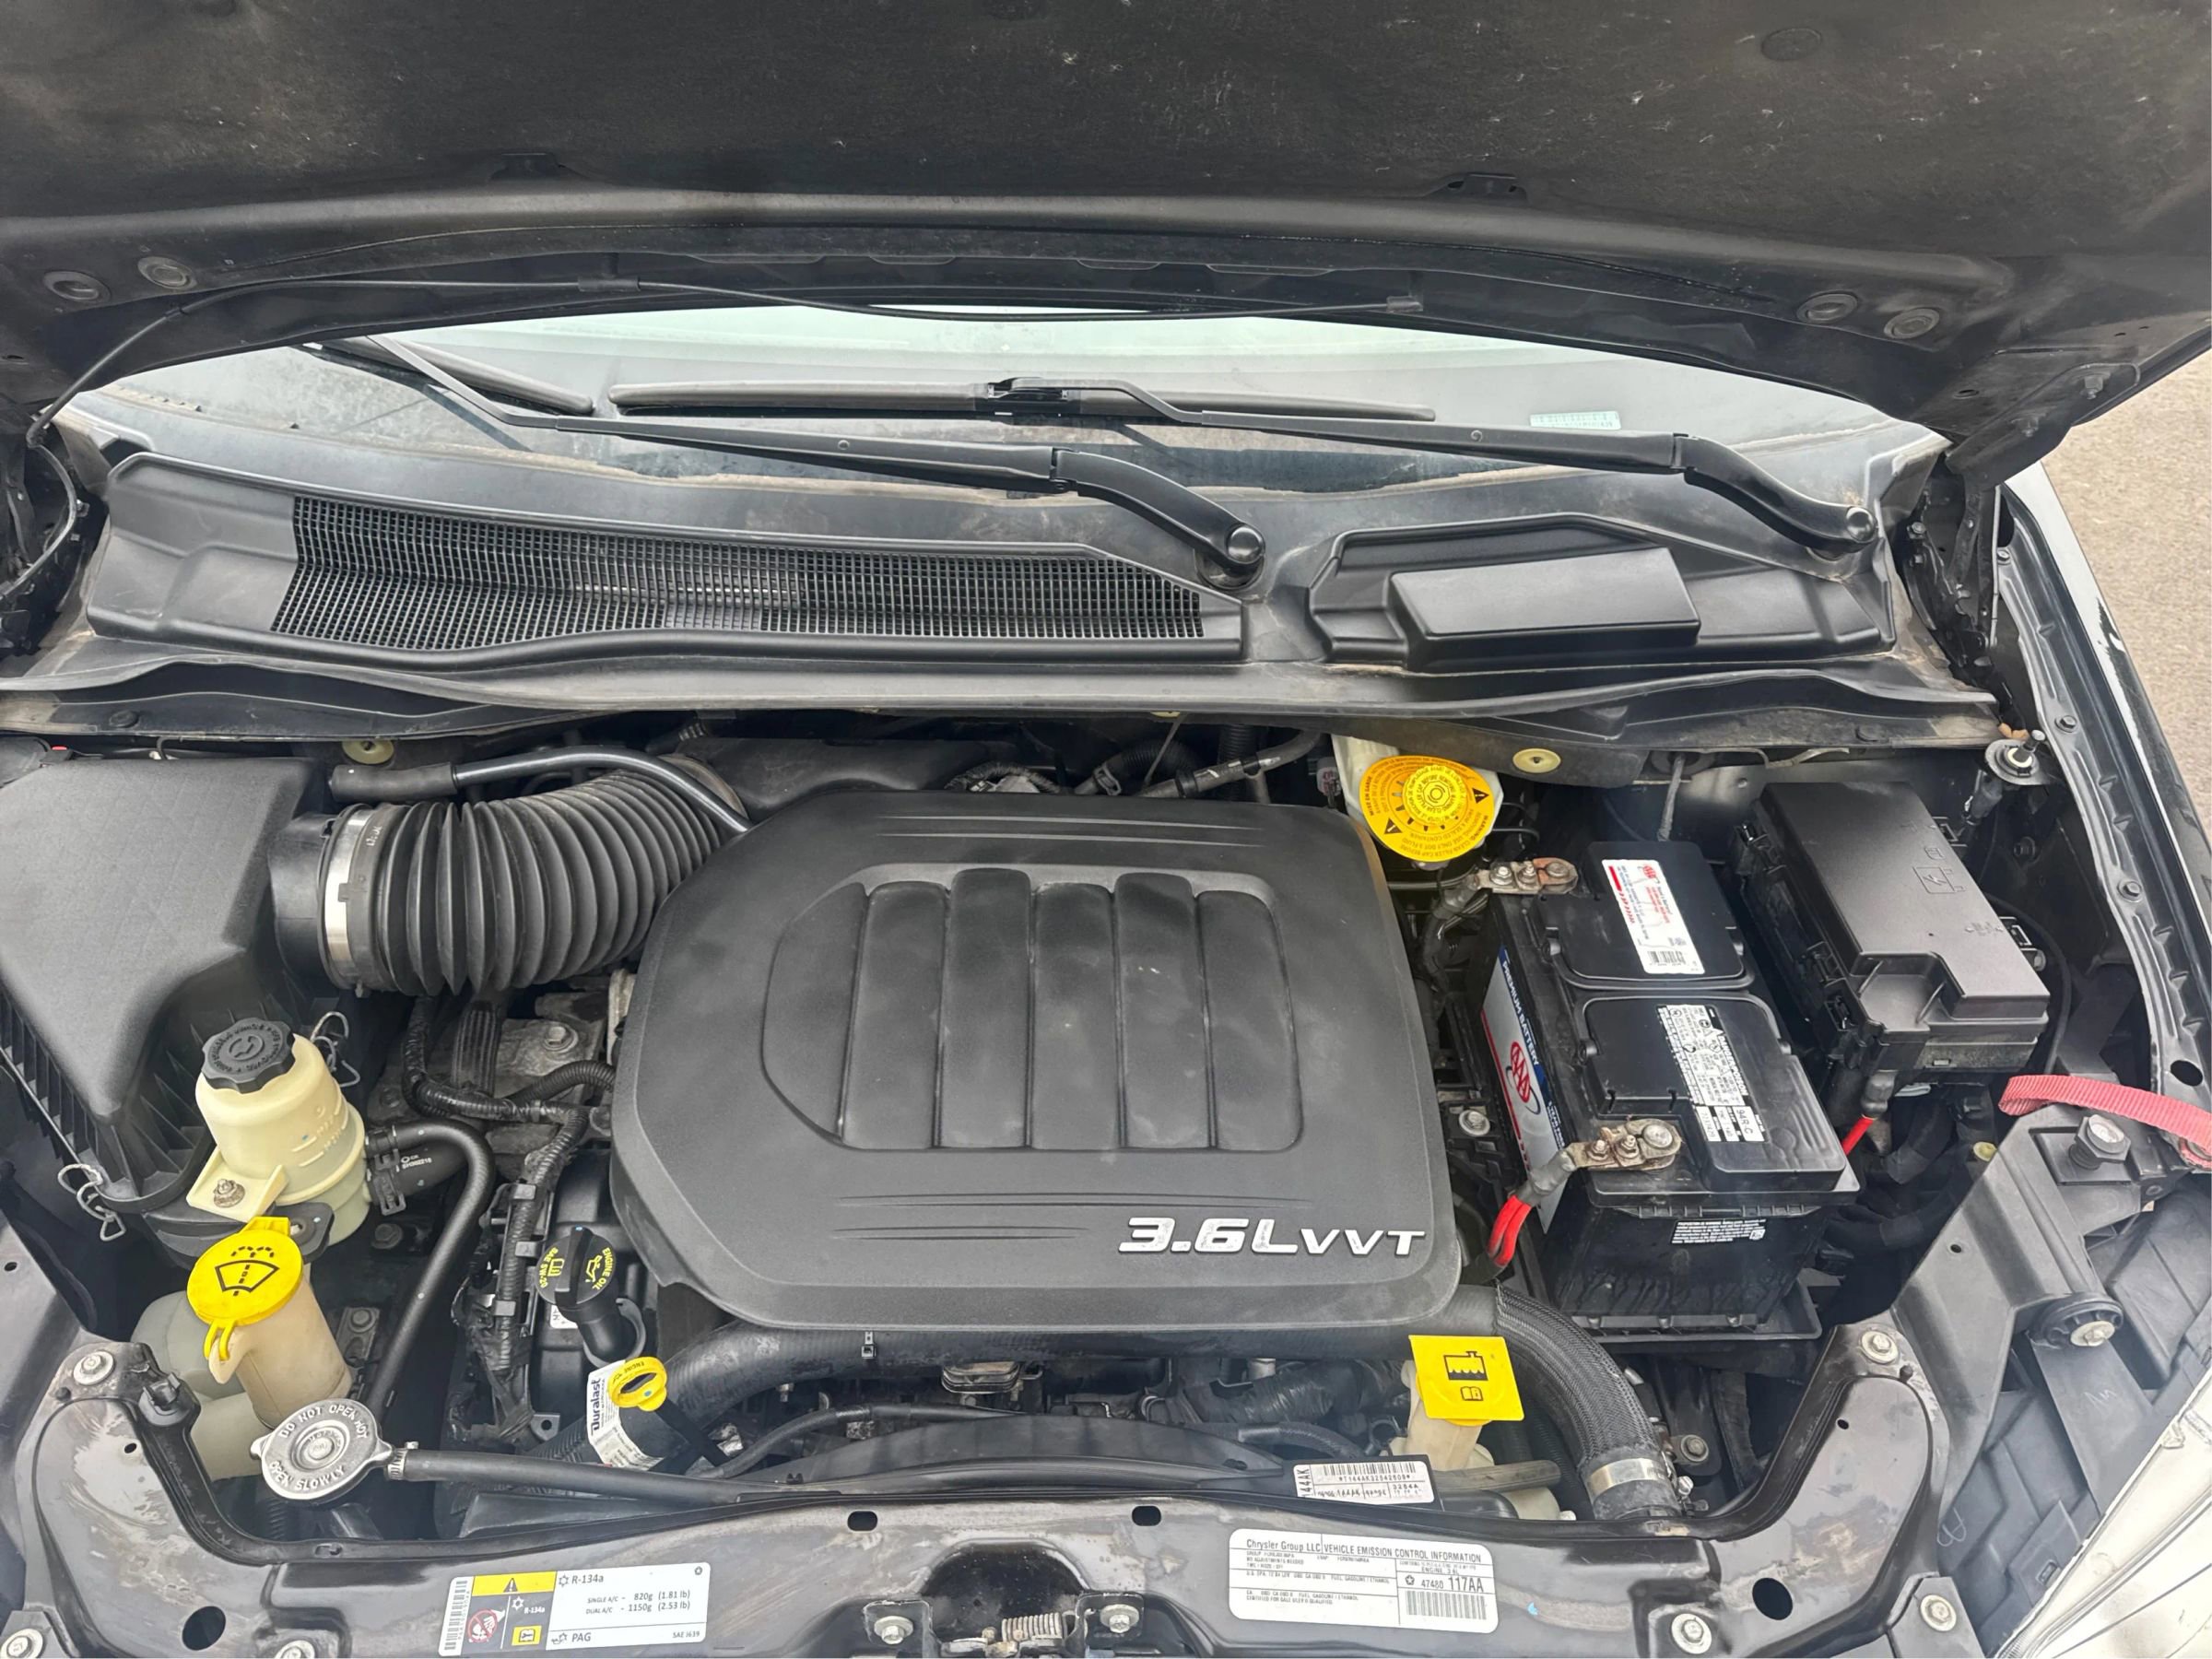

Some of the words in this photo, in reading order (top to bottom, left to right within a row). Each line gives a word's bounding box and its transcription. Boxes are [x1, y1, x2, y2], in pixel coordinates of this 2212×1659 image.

[1502, 960, 1522, 1014] PREMIUM
[1521, 1013, 1540, 1067] BATTERY
[1510, 1043, 1531, 1102] AAA
[1118, 1217, 1299, 1254] 3.6L
[1300, 1228, 1426, 1255] VVT
[544, 1247, 559, 1263] SAE
[602, 1248, 615, 1277] ENGINE
[592, 1277, 606, 1290] OIL
[625, 1360, 645, 1374] ENGINE
[590, 1378, 602, 1436] Duralast
[278, 1423, 296, 1439] DO
[298, 1406, 323, 1423] NOT
[328, 1405, 359, 1421] OPEN
[354, 1419, 369, 1440] HOT
[269, 1459, 295, 1488] OPEN
[295, 1465, 347, 1491] SLOWLY
[1246, 1539, 1279, 1551] Chrysler
[1281, 1540, 1304, 1554] Group
[1306, 1541, 1321, 1552] LLC
[1324, 1543, 1355, 1554] VEHICLE
[1357, 1546, 1393, 1558] EMISSION
[1394, 1548, 1429, 1559] CONTROL
[1430, 1550, 1482, 1563] INFORMATION
[571, 1574, 605, 1584] R-134a
[1421, 1580, 1443, 1589] 47480
[1449, 1576, 1484, 1593] 117AA
[633, 1592, 653, 1602] 820g
[658, 1591, 677, 1600] (1.81
[679, 1589, 691, 1600] lb)
[524, 1606, 546, 1615] R-134a
[599, 1606, 614, 1615] A/C
[628, 1603, 653, 1613] 1150g
[657, 1602, 678, 1611] (2.53
[679, 1600, 691, 1611] lb)
[571, 1633, 592, 1642] PAG
[686, 1630, 700, 1639] J639
